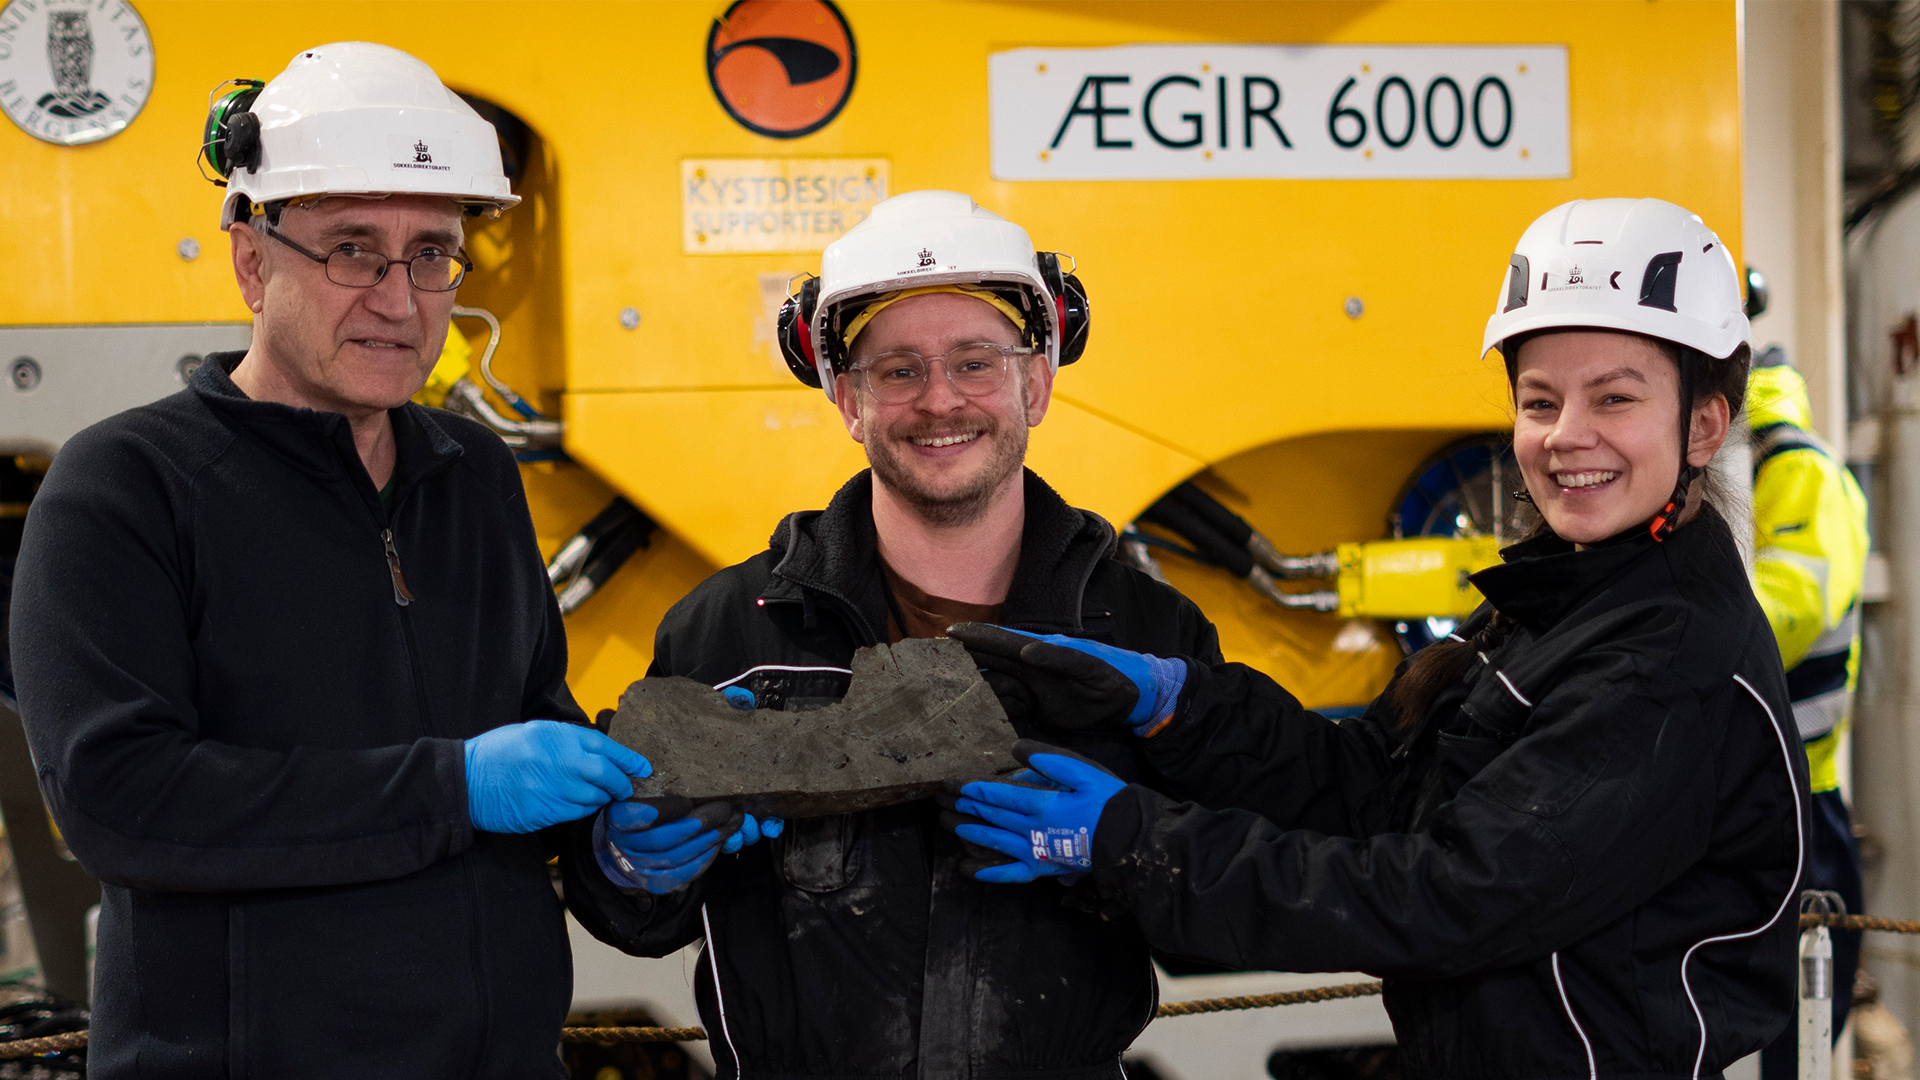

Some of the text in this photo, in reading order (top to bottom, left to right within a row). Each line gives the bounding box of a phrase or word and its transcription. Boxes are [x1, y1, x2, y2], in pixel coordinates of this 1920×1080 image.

[1049, 75, 1514, 149] ÆGIR 6000
[393, 163, 451, 171] SOKKELDIREKTORATET
[687, 175, 888, 205] KYSTDESIGN
[691, 209, 846, 235] SUPPORTER
